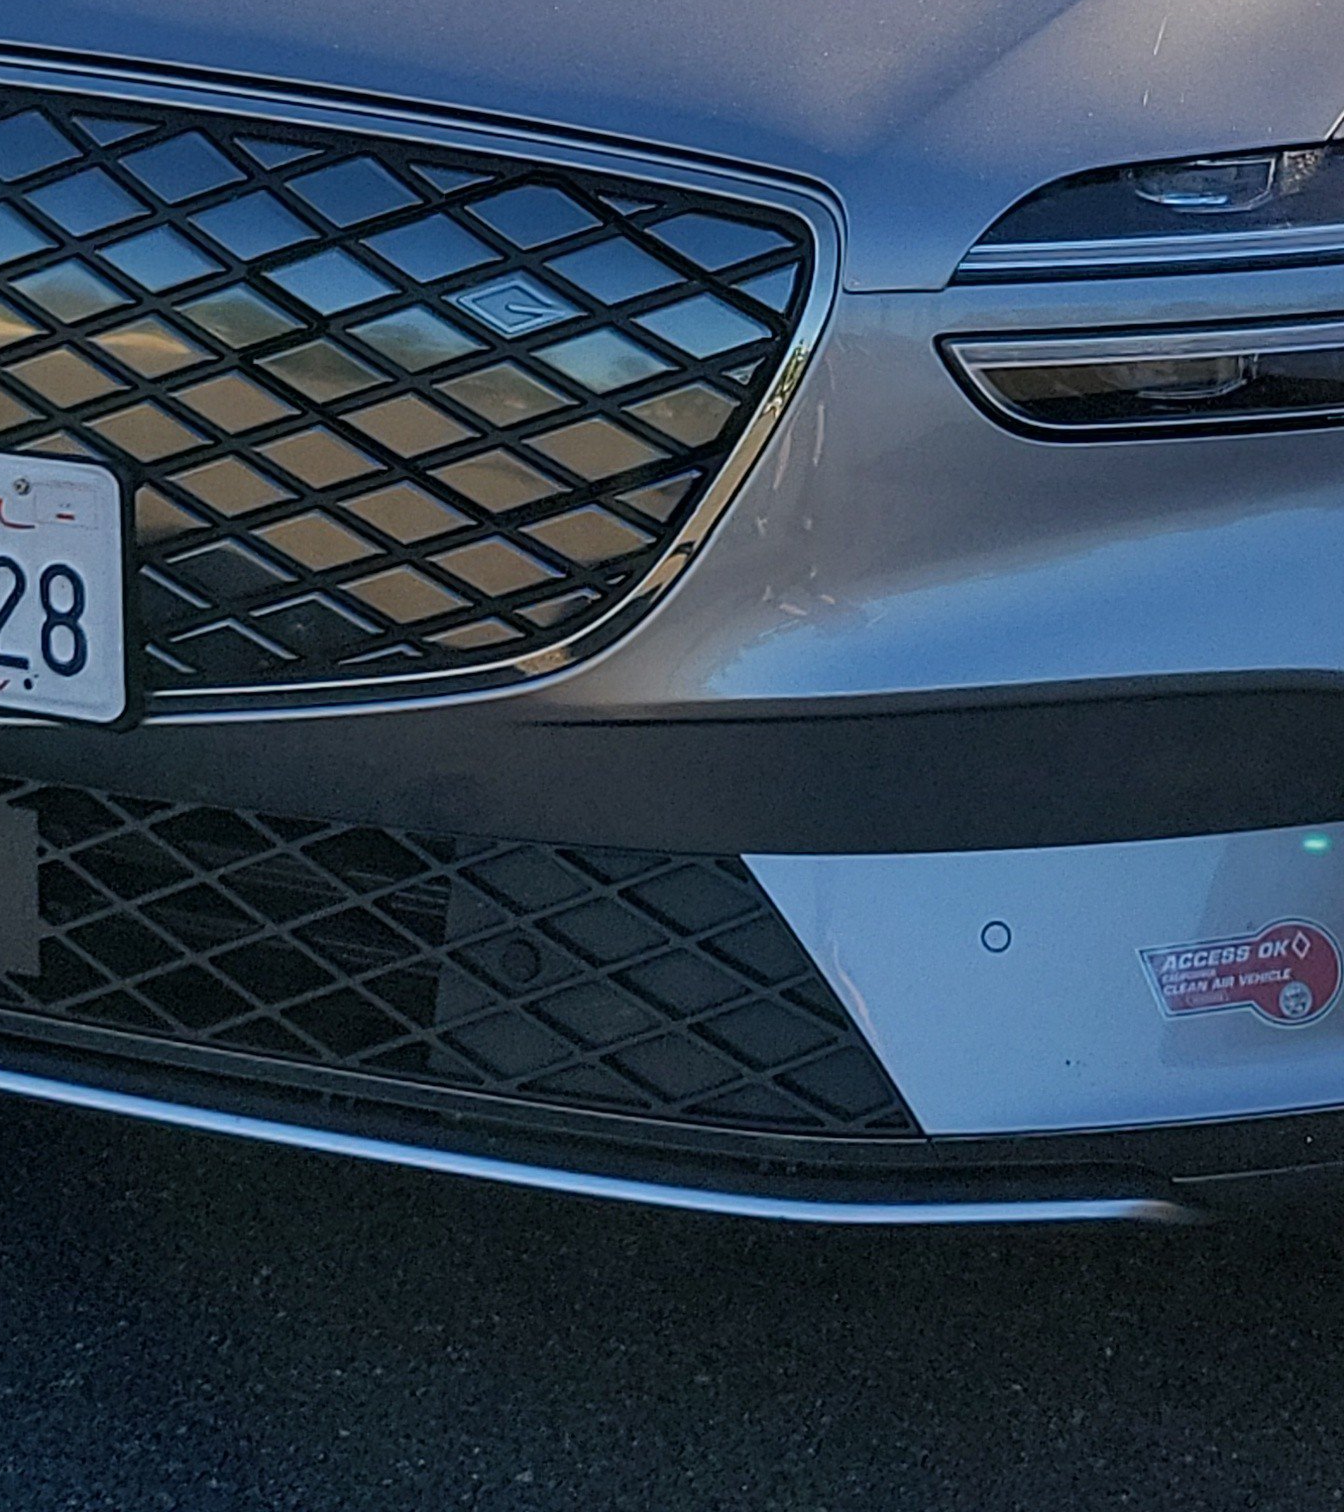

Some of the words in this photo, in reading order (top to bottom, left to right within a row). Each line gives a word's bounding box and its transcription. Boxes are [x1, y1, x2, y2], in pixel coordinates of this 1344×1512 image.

[1160, 945, 1251, 971] ACCESS
[1258, 938, 1294, 959] OK
[1162, 981, 1210, 996] CLEAN
[1211, 974, 1236, 991] AIR
[1239, 967, 1293, 987] VEHICLE
